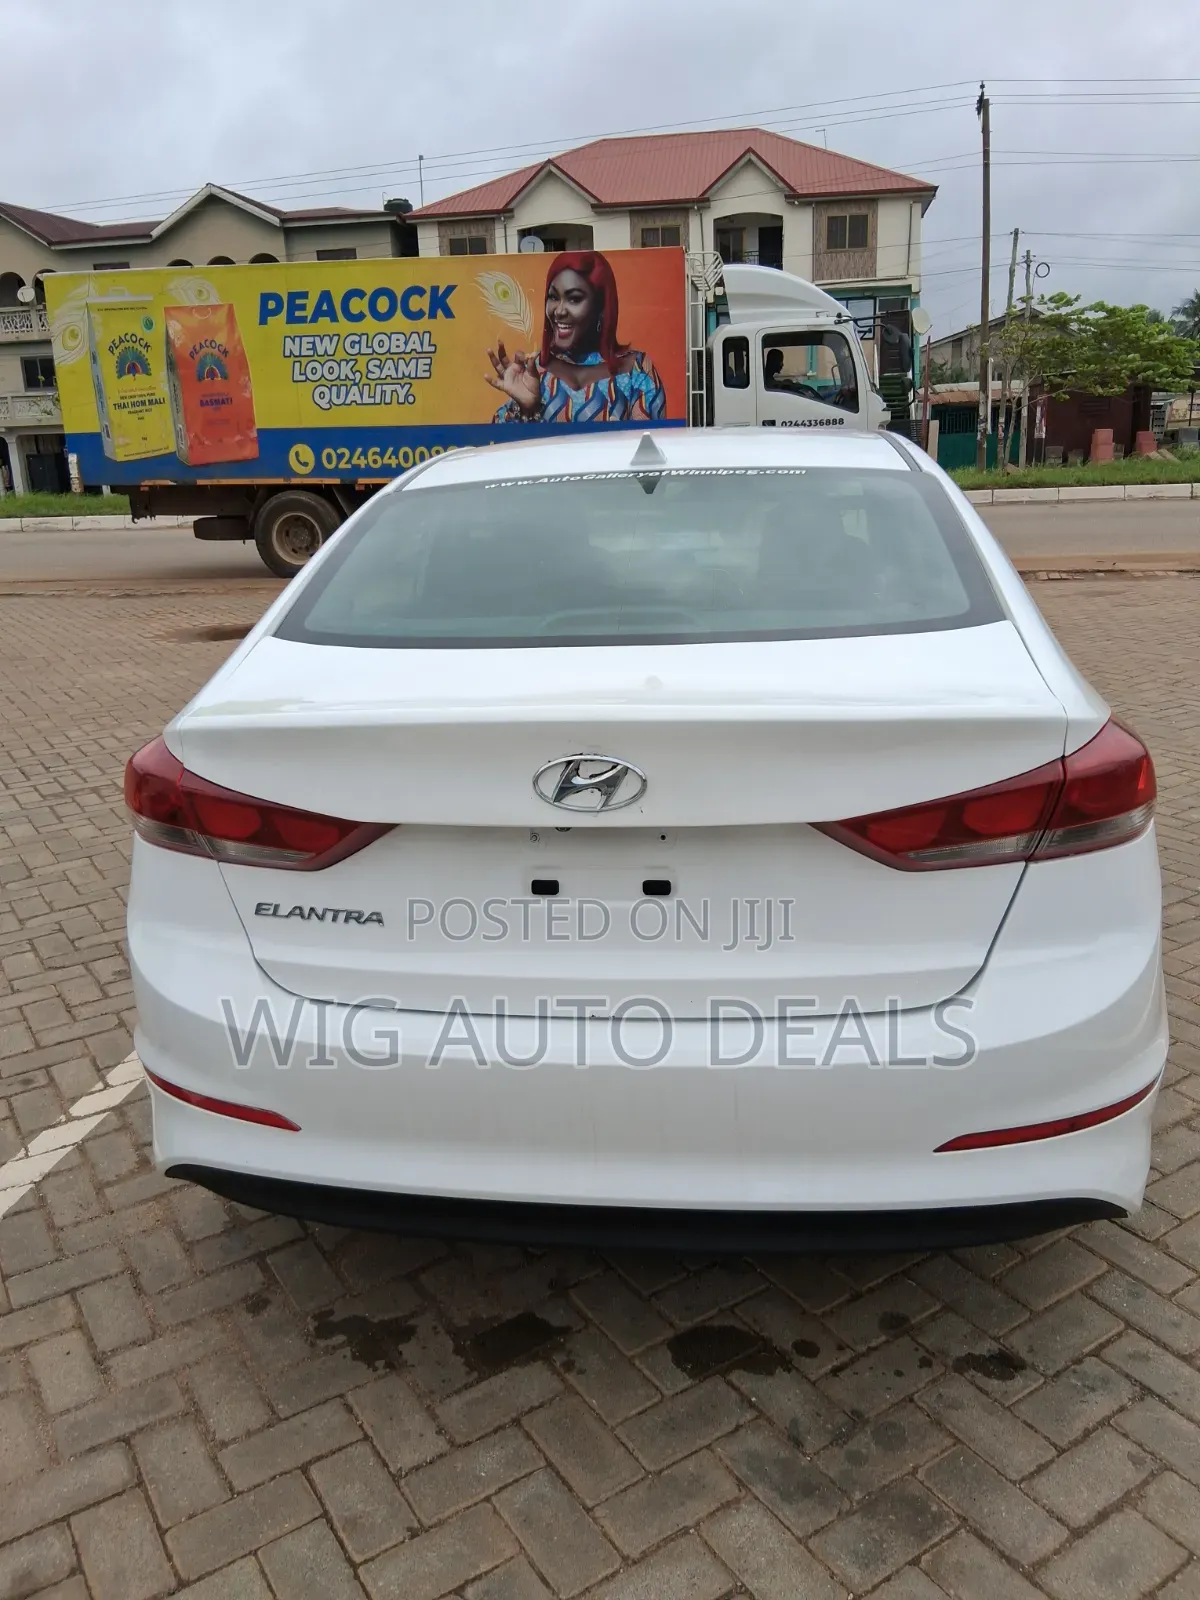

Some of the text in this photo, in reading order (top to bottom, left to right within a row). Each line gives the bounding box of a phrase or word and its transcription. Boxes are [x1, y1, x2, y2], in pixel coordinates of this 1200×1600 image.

[258, 284, 458, 326] PEACOCK
[108, 332, 152, 356] PEACOCK
[189, 338, 229, 360] PEACOCK
[283, 331, 437, 358] NEW GLOBAL
[292, 356, 433, 386] LOOK, SAME
[113, 397, 166, 410] THAI HOM MALI
[200, 398, 233, 407] BASMATI
[312, 382, 416, 411] QUALITY.
[253, 902, 385, 926] ELANTRA
